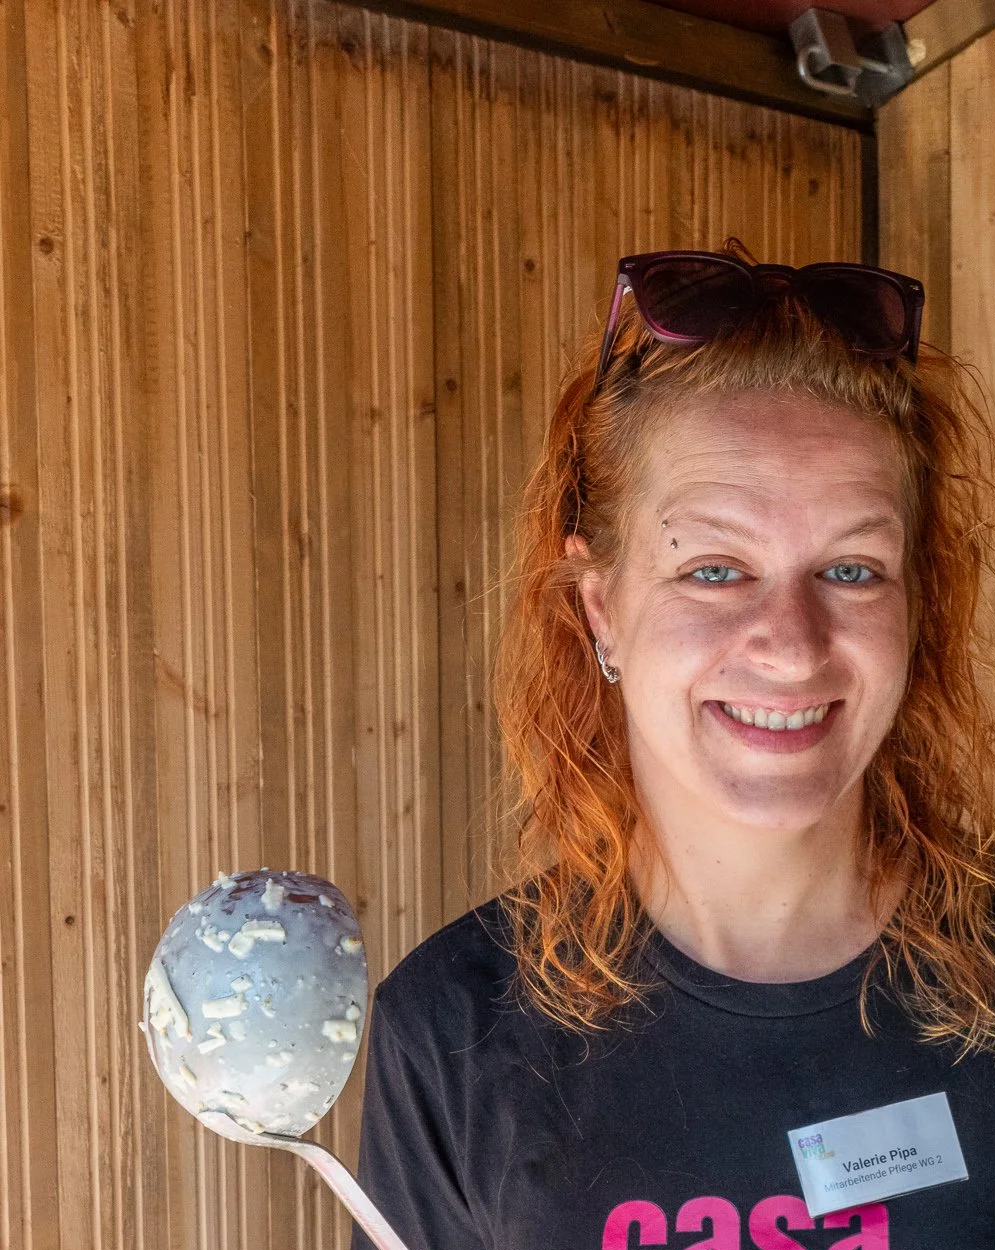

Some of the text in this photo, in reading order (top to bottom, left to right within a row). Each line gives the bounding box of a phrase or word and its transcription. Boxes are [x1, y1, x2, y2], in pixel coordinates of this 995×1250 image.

[824, 1154, 943, 1192] Mitarbeitende Pflege WG 2
[842, 1154, 887, 1173] Valerie
[889, 1147, 917, 1161] Pipa
